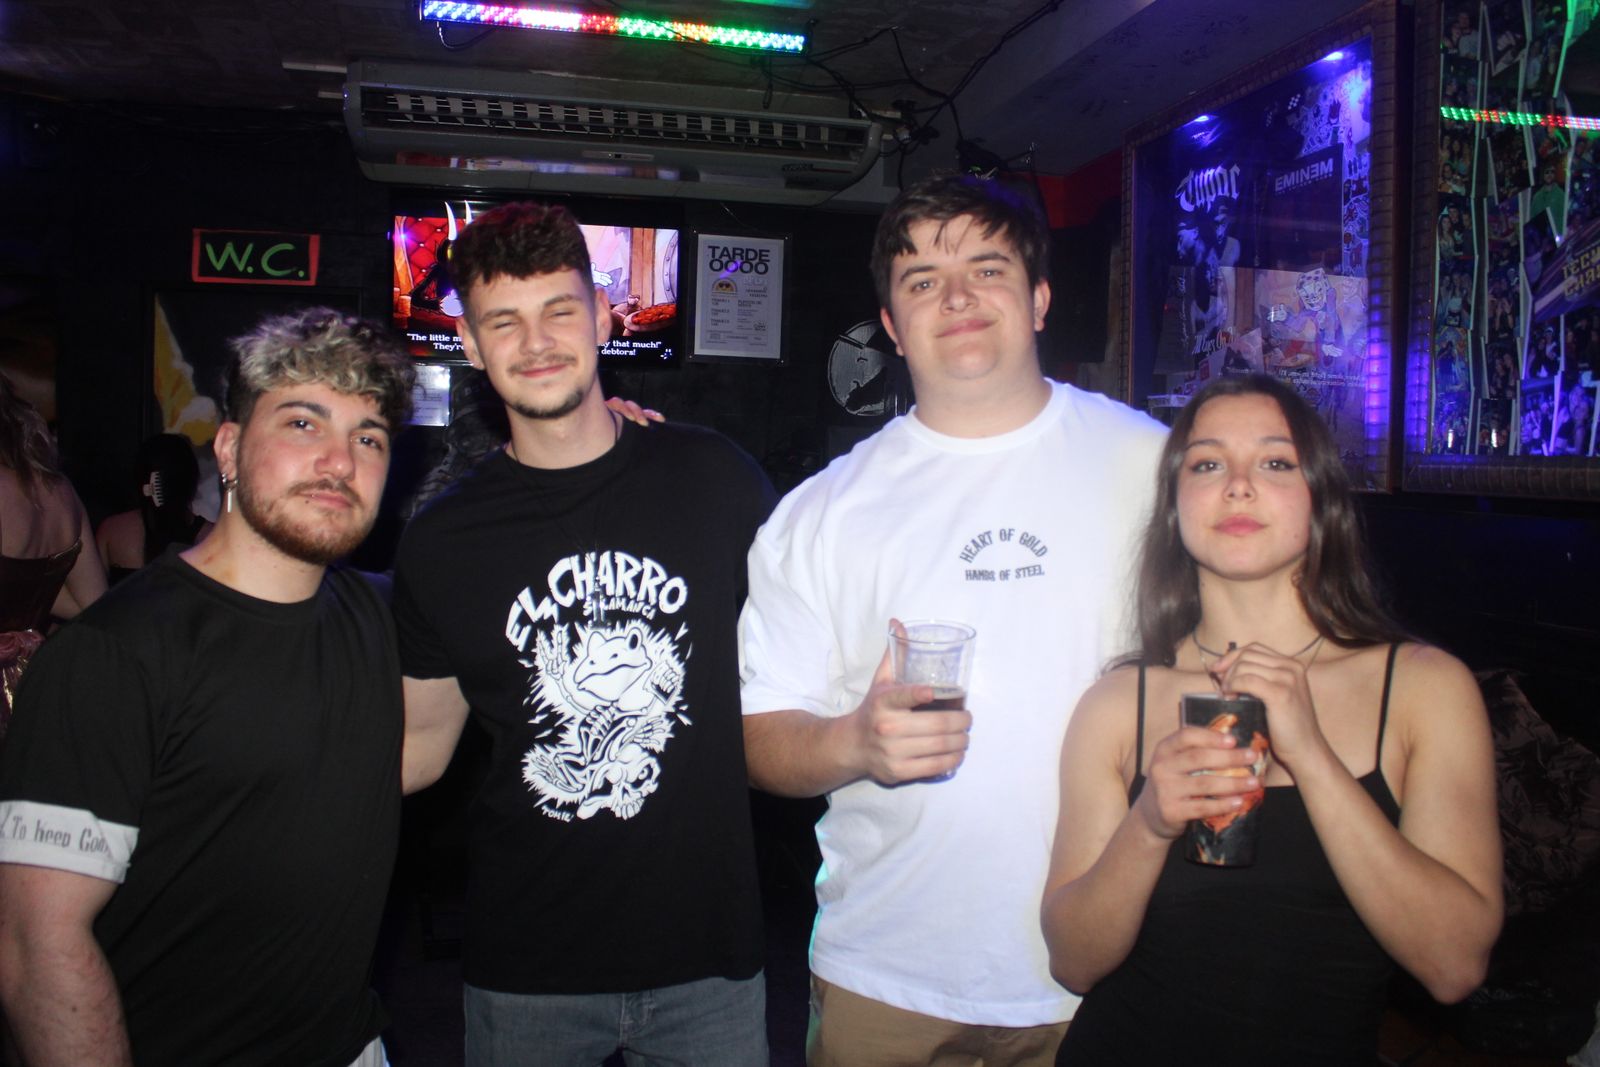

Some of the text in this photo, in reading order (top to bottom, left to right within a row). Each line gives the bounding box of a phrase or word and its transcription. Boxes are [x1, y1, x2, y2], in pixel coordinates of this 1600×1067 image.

[1274, 157, 1334, 192] EMINEM
[205, 241, 305, 278] W.C.
[707, 245, 771, 263] TARDE
[429, 333, 451, 342] little
[612, 339, 630, 348] that
[601, 347, 636, 356] debtors!
[959, 527, 1048, 564] HEART OF GOLD
[999, 569, 1011, 581] OF
[505, 550, 688, 653] EL CHARRO
[12, 815, 27, 840] To
